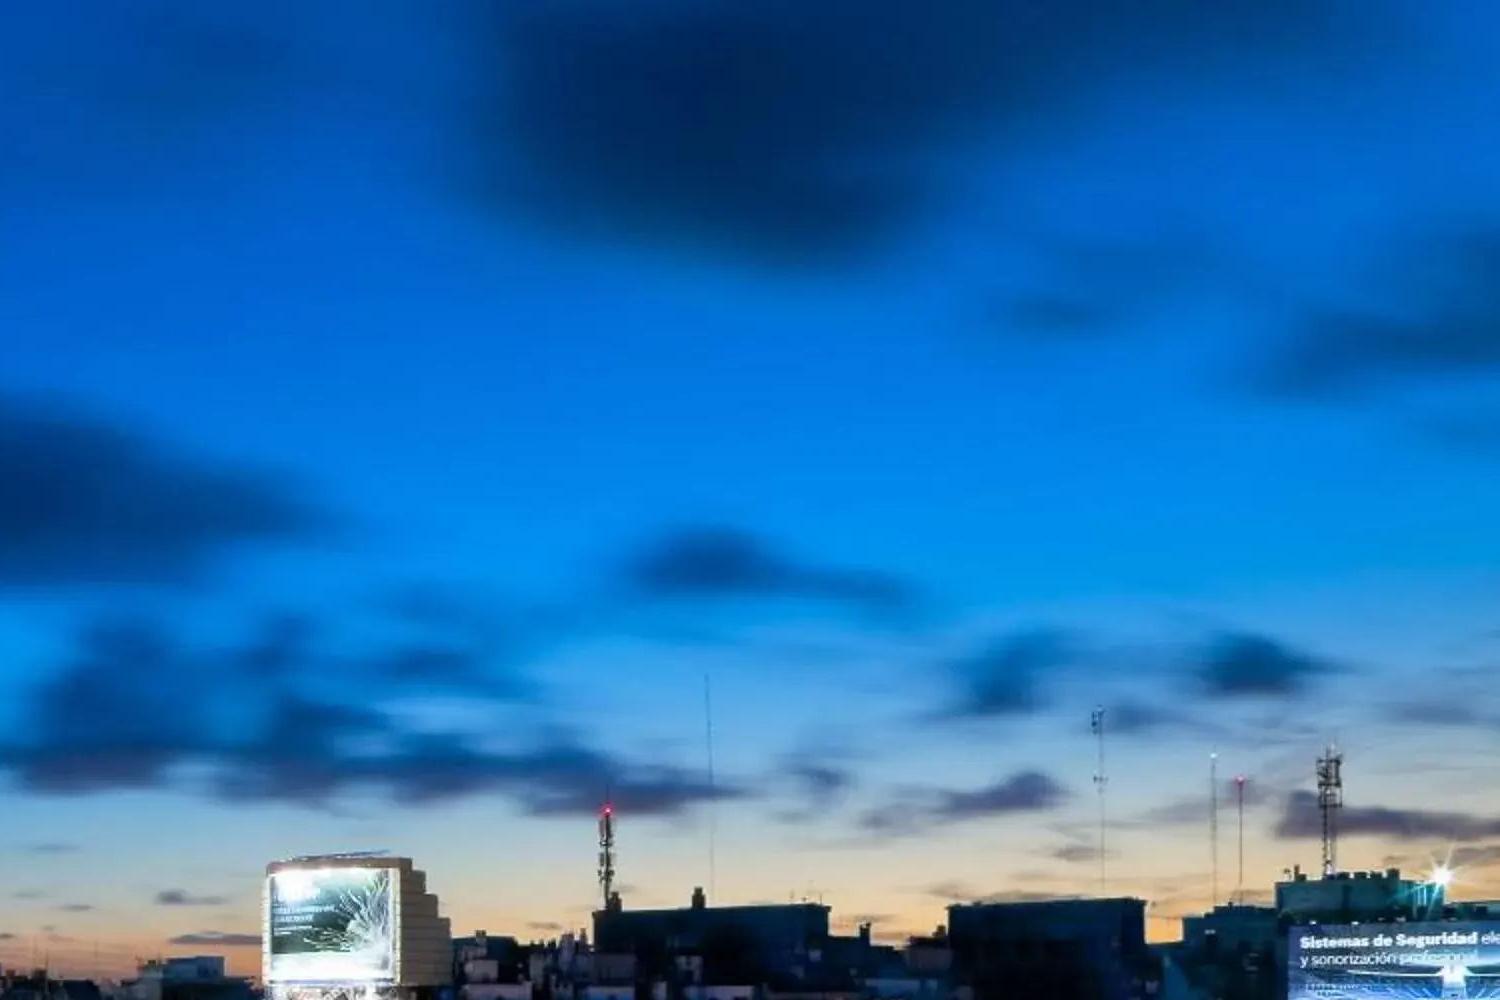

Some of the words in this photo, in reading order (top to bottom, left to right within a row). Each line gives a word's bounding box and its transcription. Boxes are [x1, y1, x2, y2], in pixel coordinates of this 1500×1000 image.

[1300, 935, 1369, 949] Sistemas
[1373, 933, 1393, 947] de
[1396, 931, 1478, 948] Seguridad
[1300, 955, 1308, 968] y
[1311, 952, 1397, 965] sonorización
